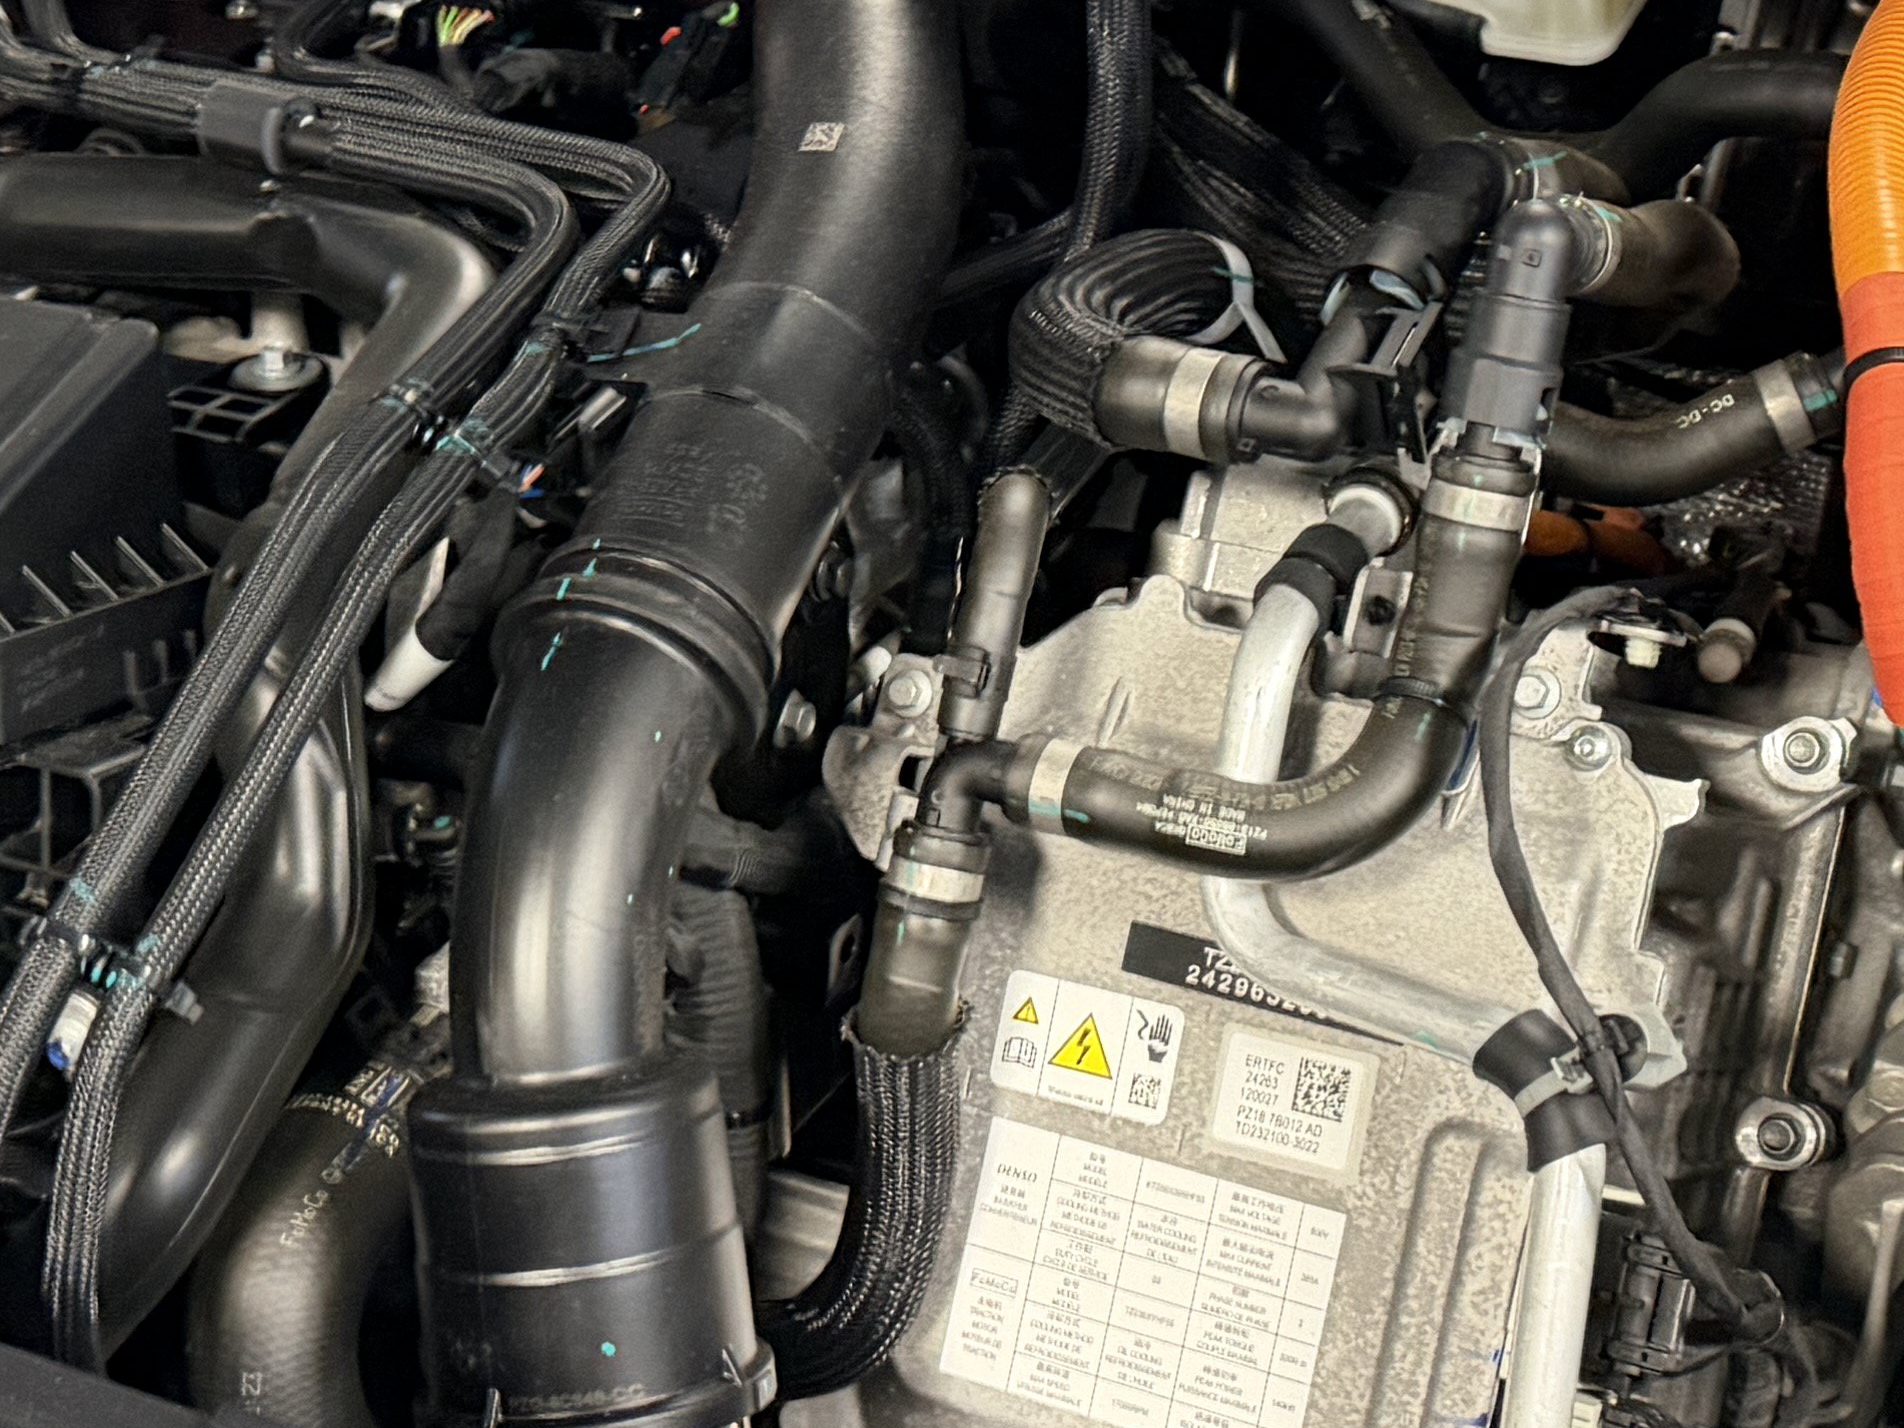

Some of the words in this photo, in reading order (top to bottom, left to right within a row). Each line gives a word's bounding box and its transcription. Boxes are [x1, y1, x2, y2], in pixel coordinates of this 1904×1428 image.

[1675, 393, 1736, 429] DC-DC
[1245, 1053, 1285, 1075] ERTFC
[996, 1161, 1038, 1184] DENSO
